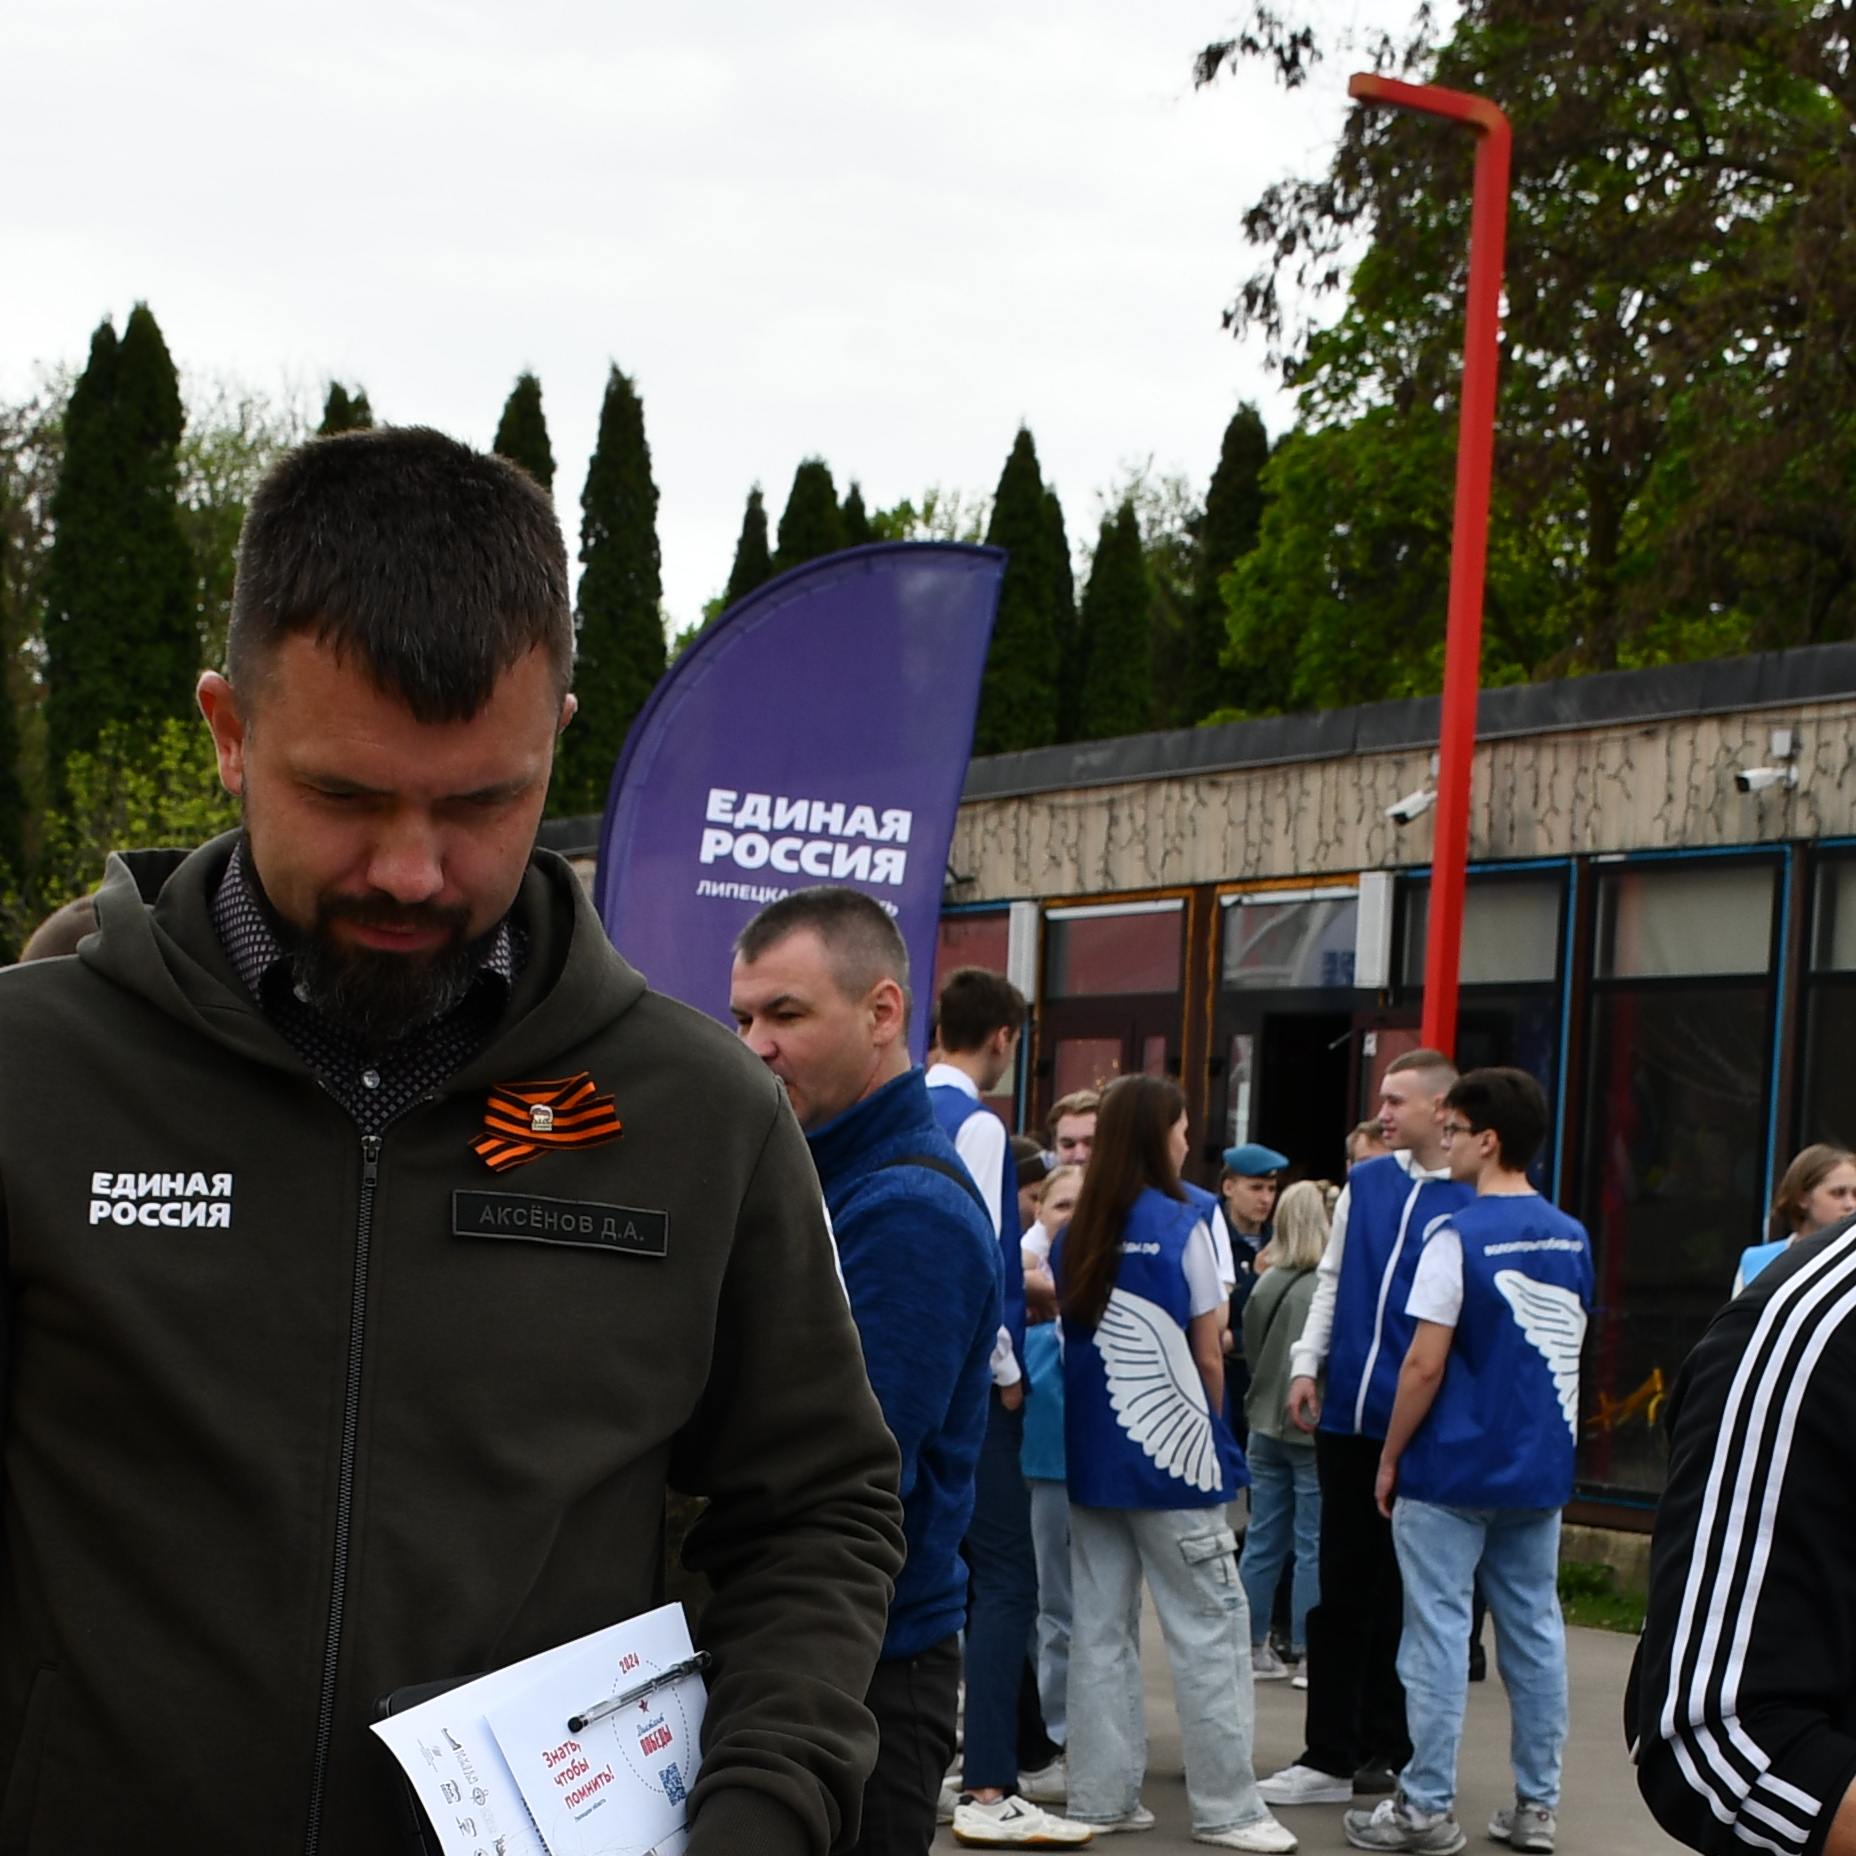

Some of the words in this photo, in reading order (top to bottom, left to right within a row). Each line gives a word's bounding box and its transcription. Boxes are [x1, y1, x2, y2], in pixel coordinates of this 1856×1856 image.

[705, 787, 913, 844] ЕДИНАЯ
[699, 827, 907, 886] РОССИЯ
[696, 879, 792, 904] ЛИПЕЦКА
[91, 1171, 233, 1200] ЕДИНАЯ
[89, 1199, 232, 1229] РОССИЯ
[479, 1203, 594, 1234] АКСЁНОВ
[600, 1216, 645, 1242] Д.А.
[618, 1652, 641, 1675] 2024
[542, 1739, 582, 1769] Знать,
[554, 1756, 591, 1788] чтобы
[563, 1763, 616, 1810] помнить!
